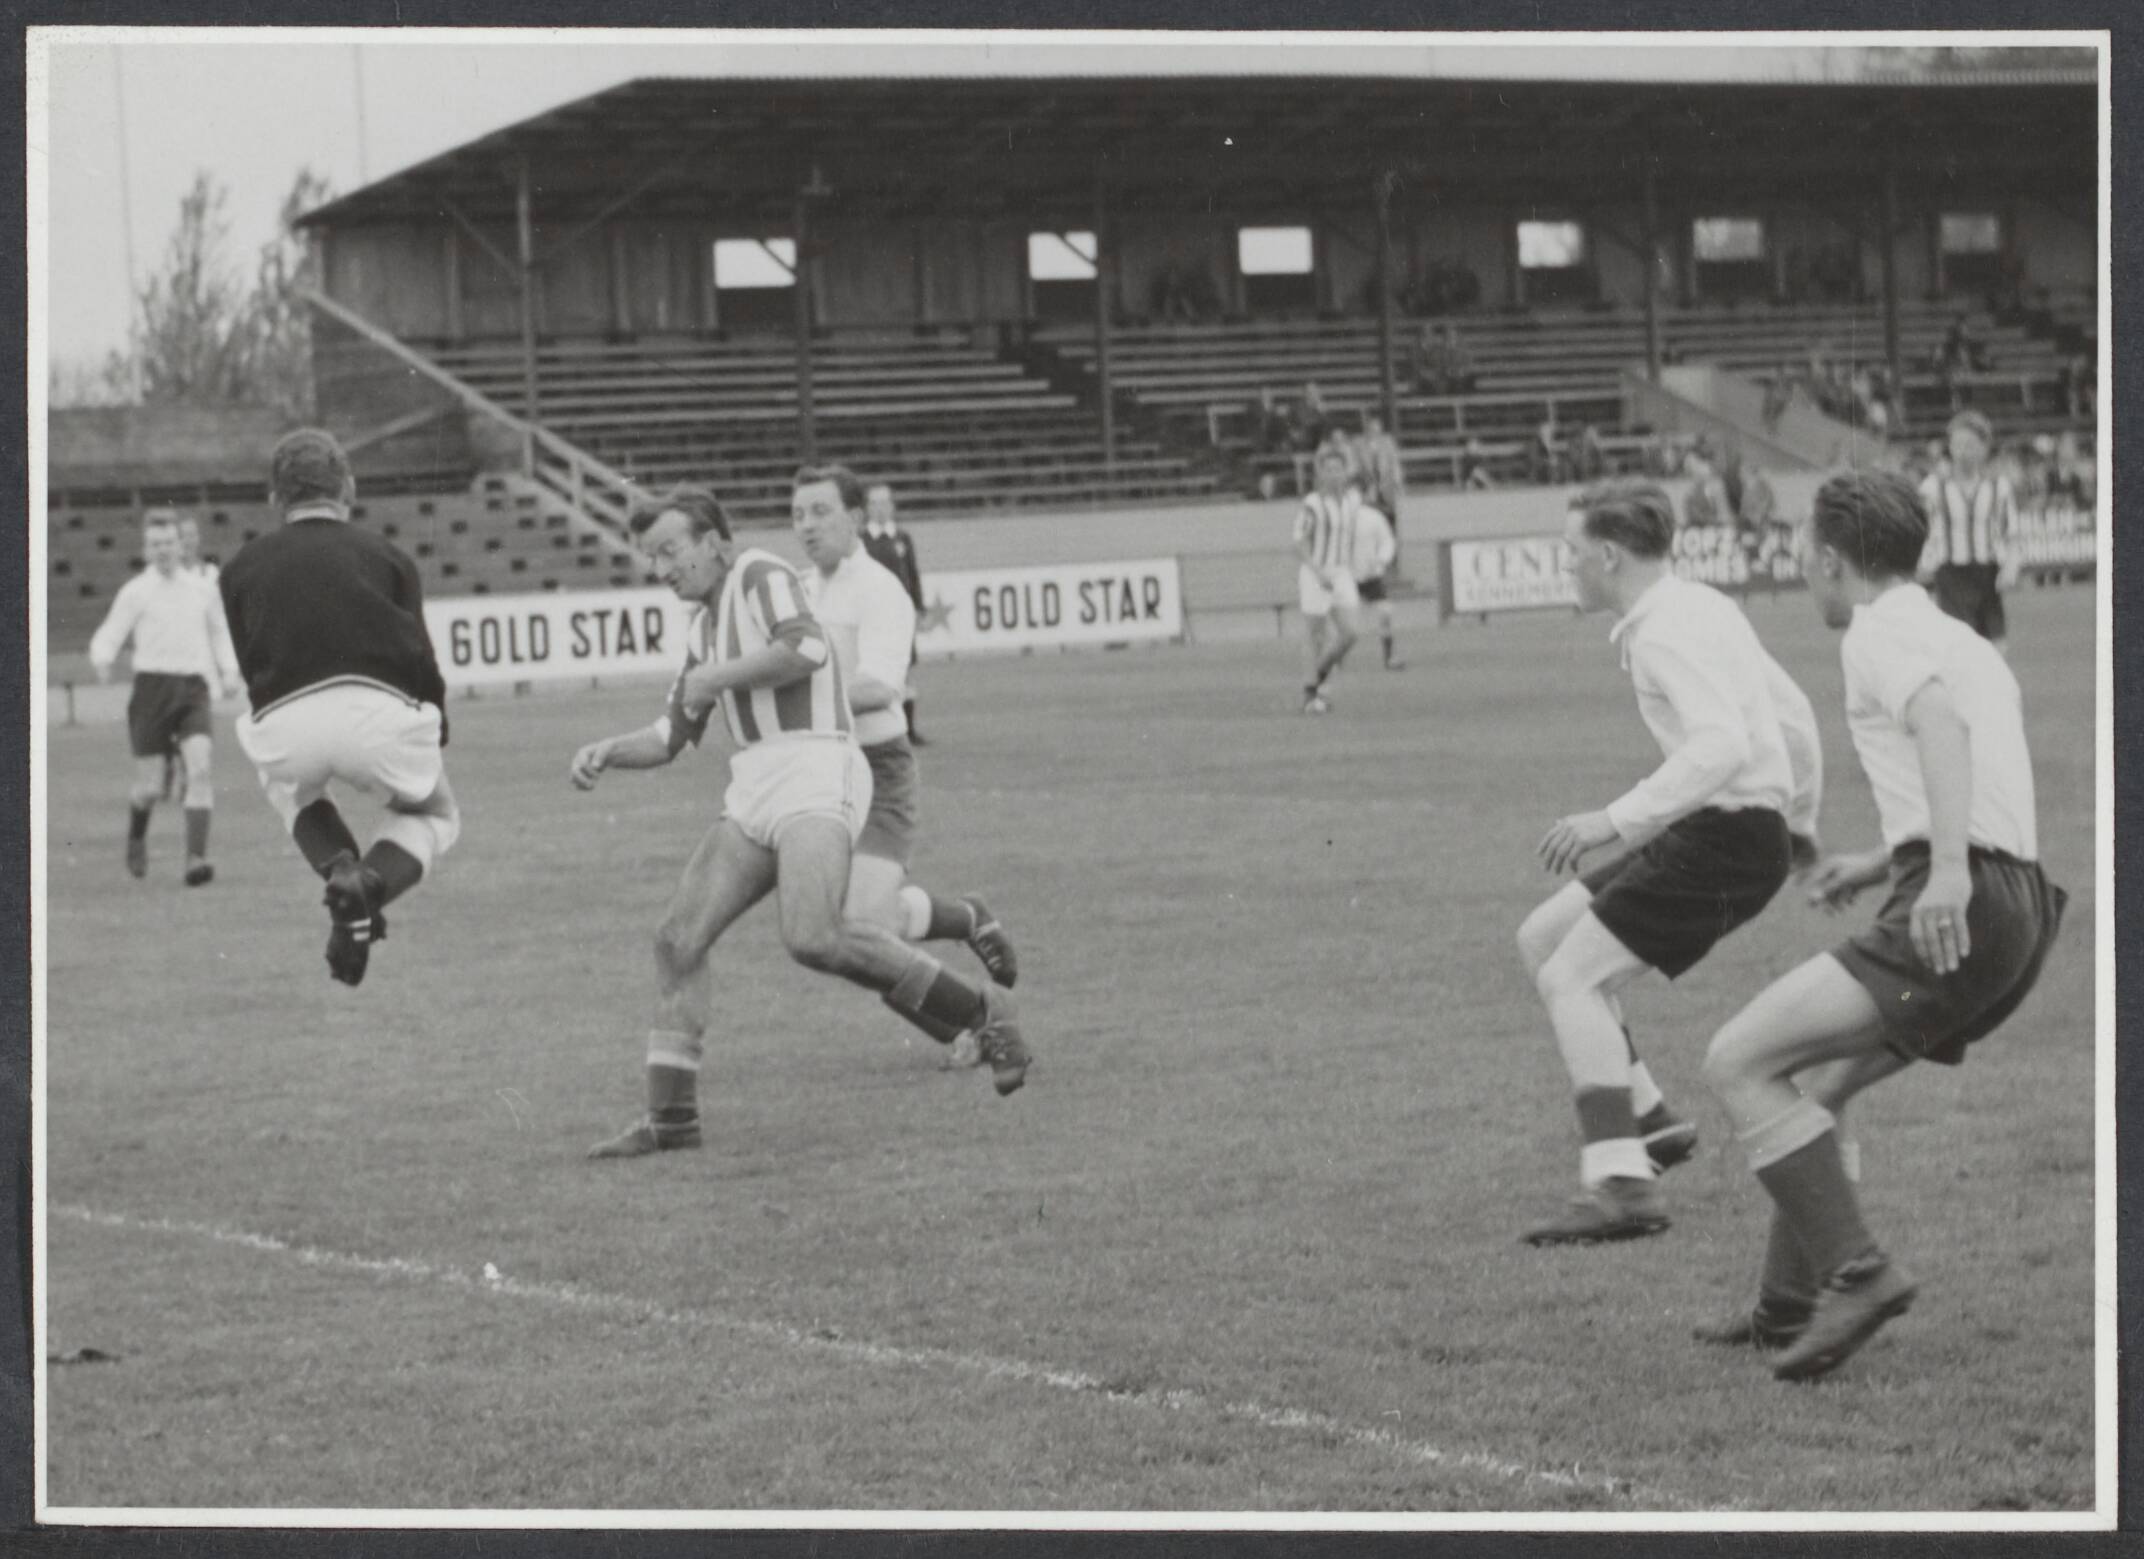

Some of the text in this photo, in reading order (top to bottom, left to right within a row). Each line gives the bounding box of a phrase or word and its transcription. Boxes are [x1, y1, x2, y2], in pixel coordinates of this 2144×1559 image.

[974, 576, 1161, 631] GOLD STAR
[451, 607, 664, 666] GOLD STAR
